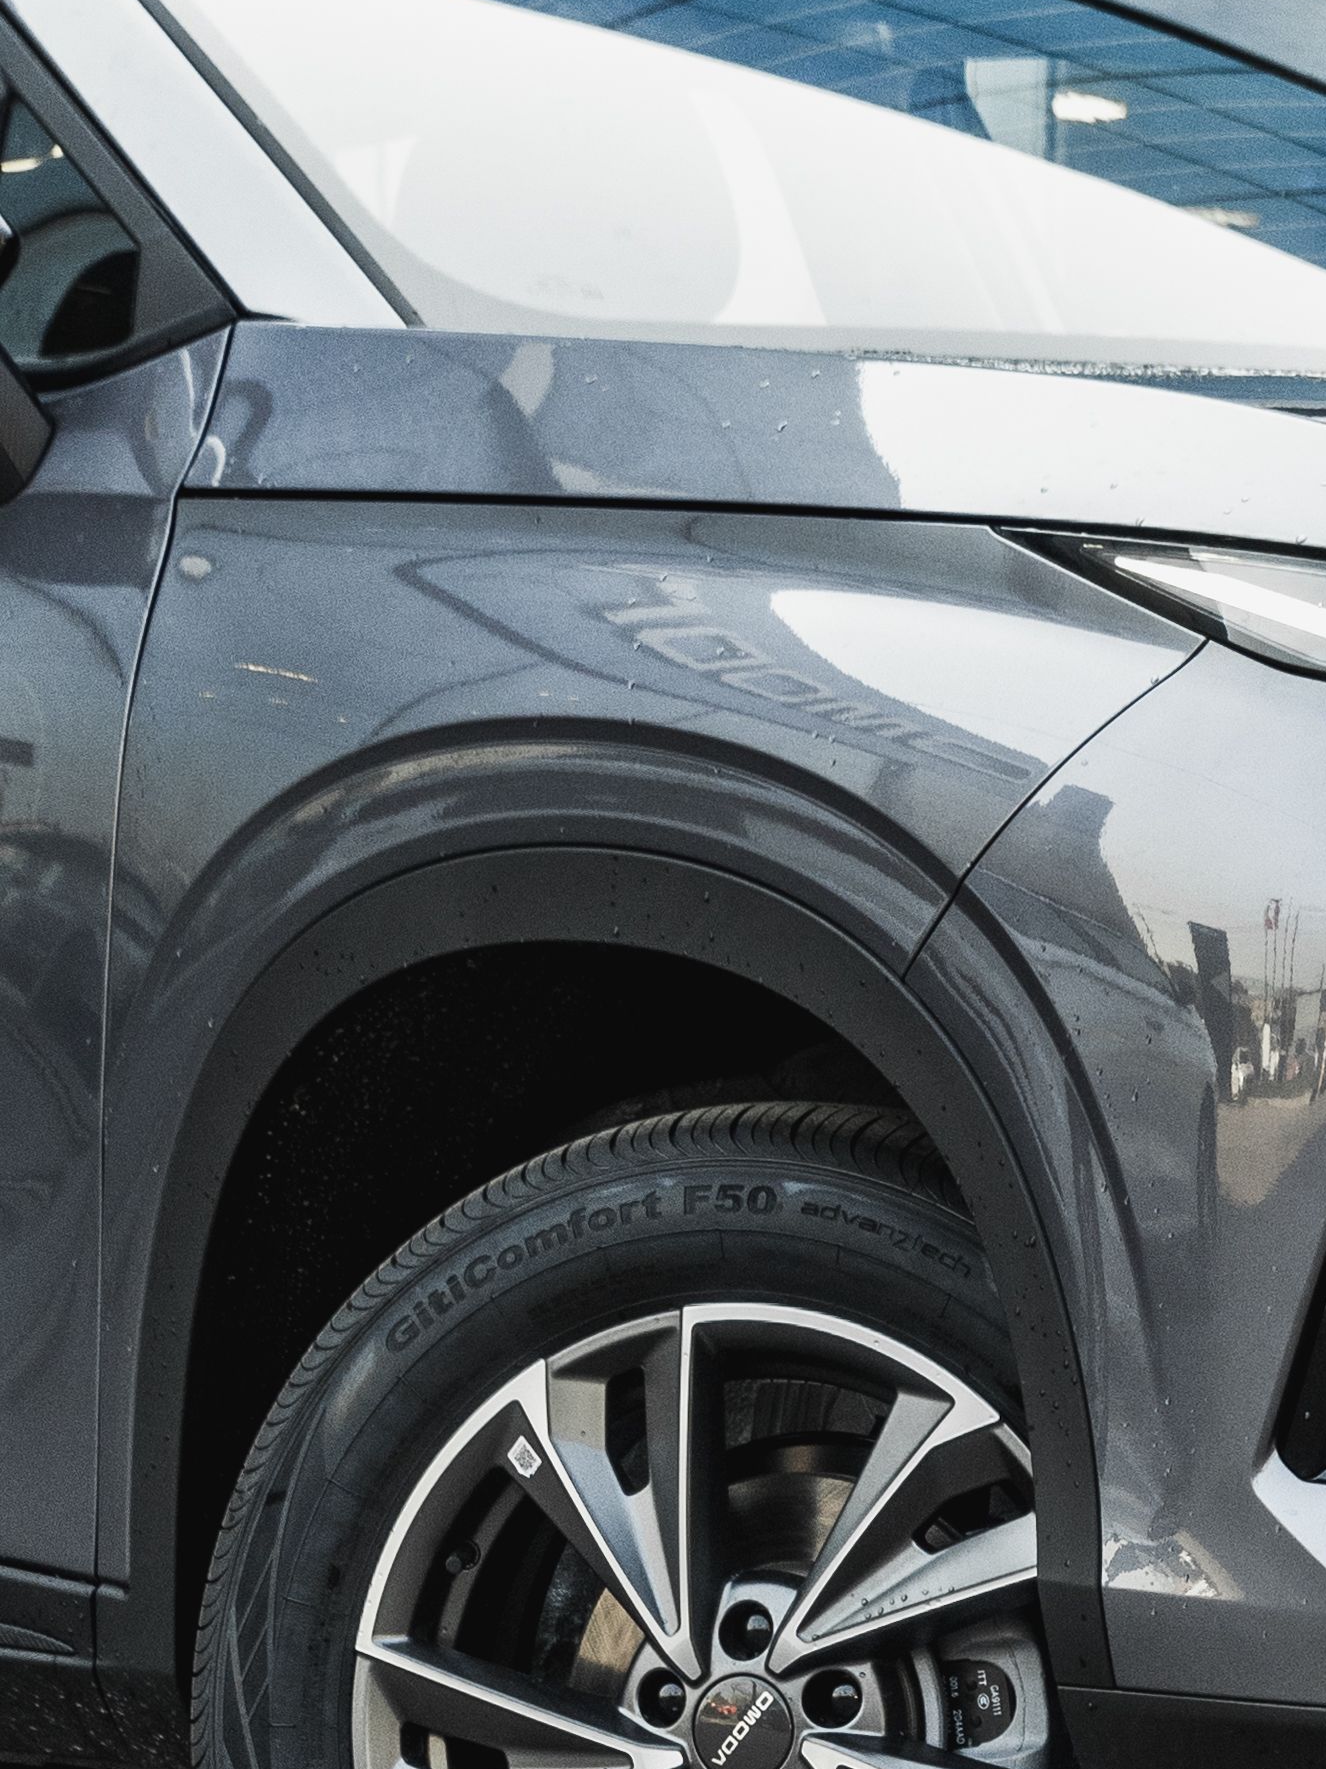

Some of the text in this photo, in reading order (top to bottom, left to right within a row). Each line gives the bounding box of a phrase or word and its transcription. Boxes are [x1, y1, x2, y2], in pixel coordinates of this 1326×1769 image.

[385, 1189, 663, 1353] GitiComfort
[683, 1184, 778, 1217] F50
[711, 1690, 775, 1767] OMODA
